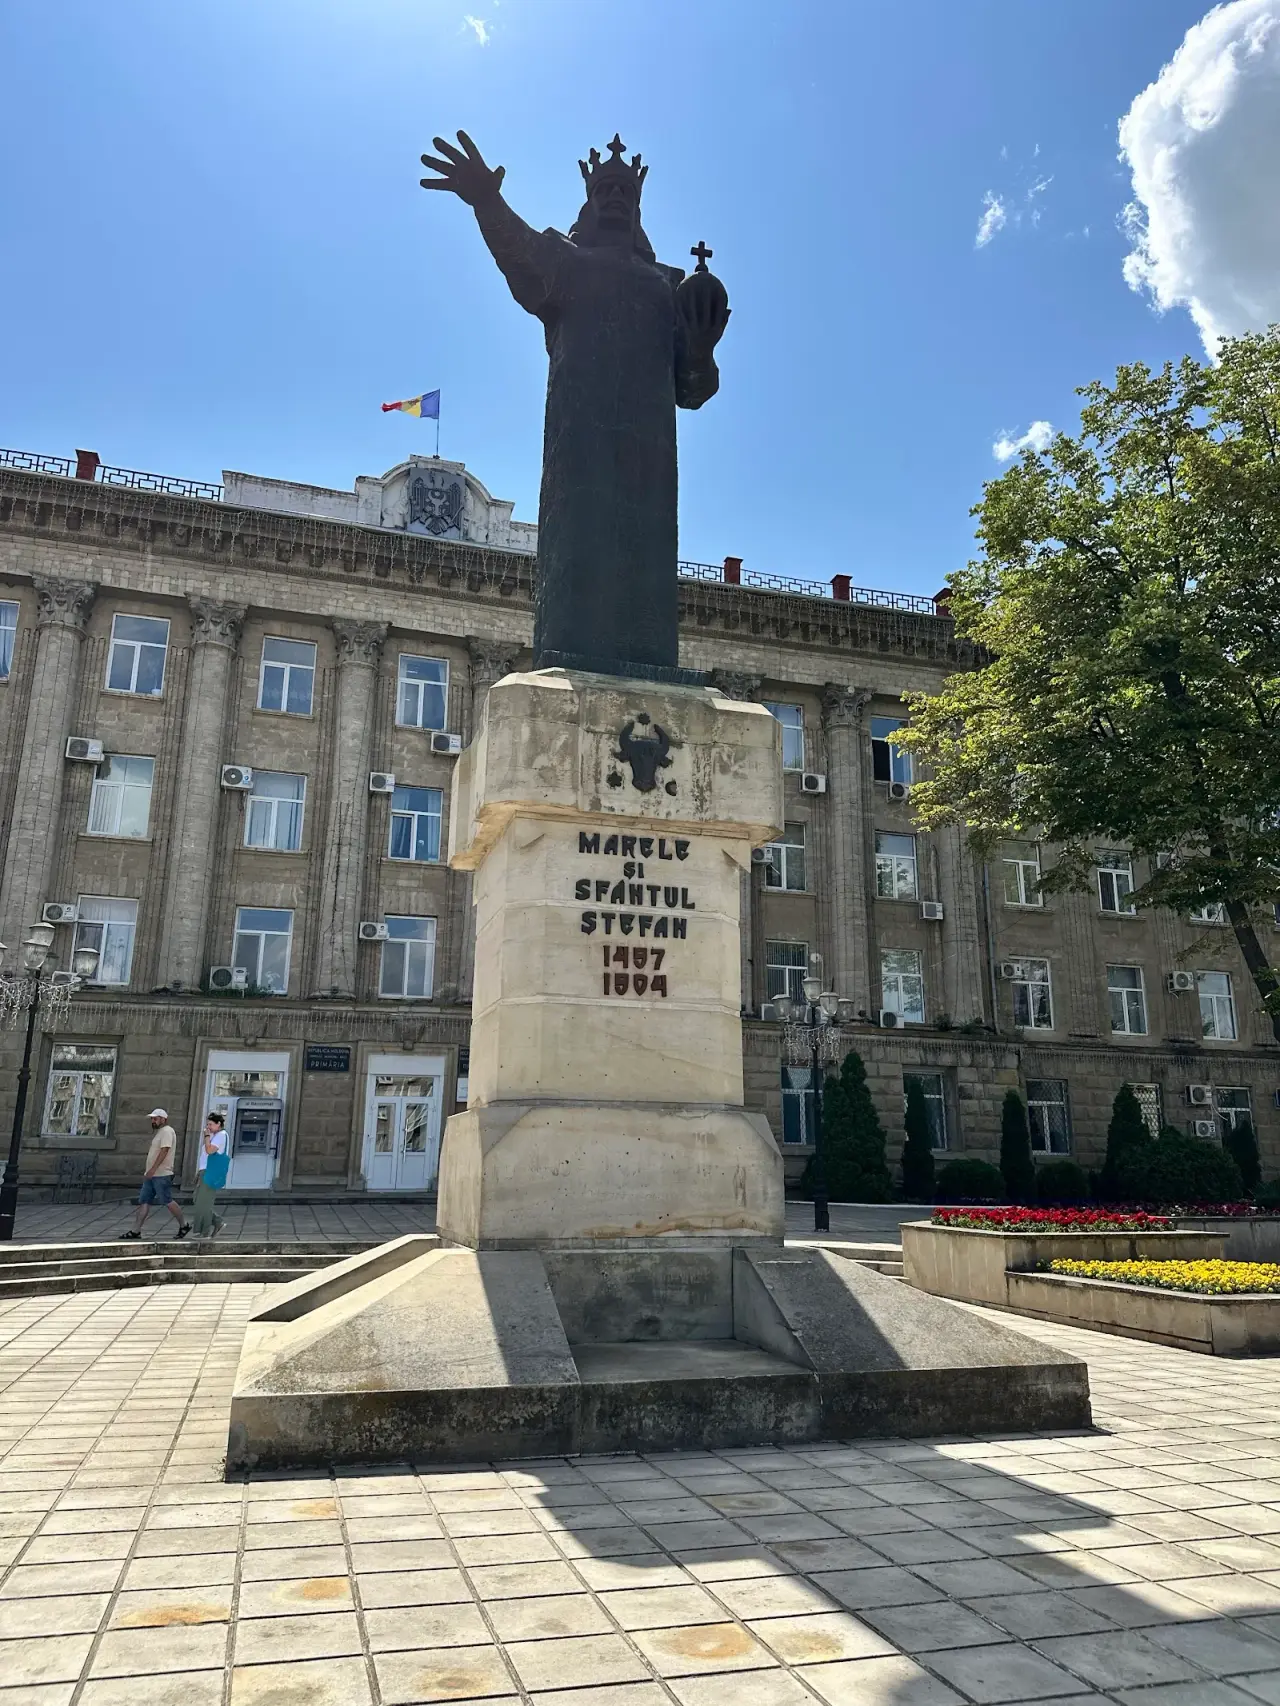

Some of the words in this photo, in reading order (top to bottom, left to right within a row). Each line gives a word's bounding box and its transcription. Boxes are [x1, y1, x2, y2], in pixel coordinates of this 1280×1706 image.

[579, 832, 690, 861] MARELE
[603, 945, 665, 970] 1457
[604, 973, 667, 997] 1504
